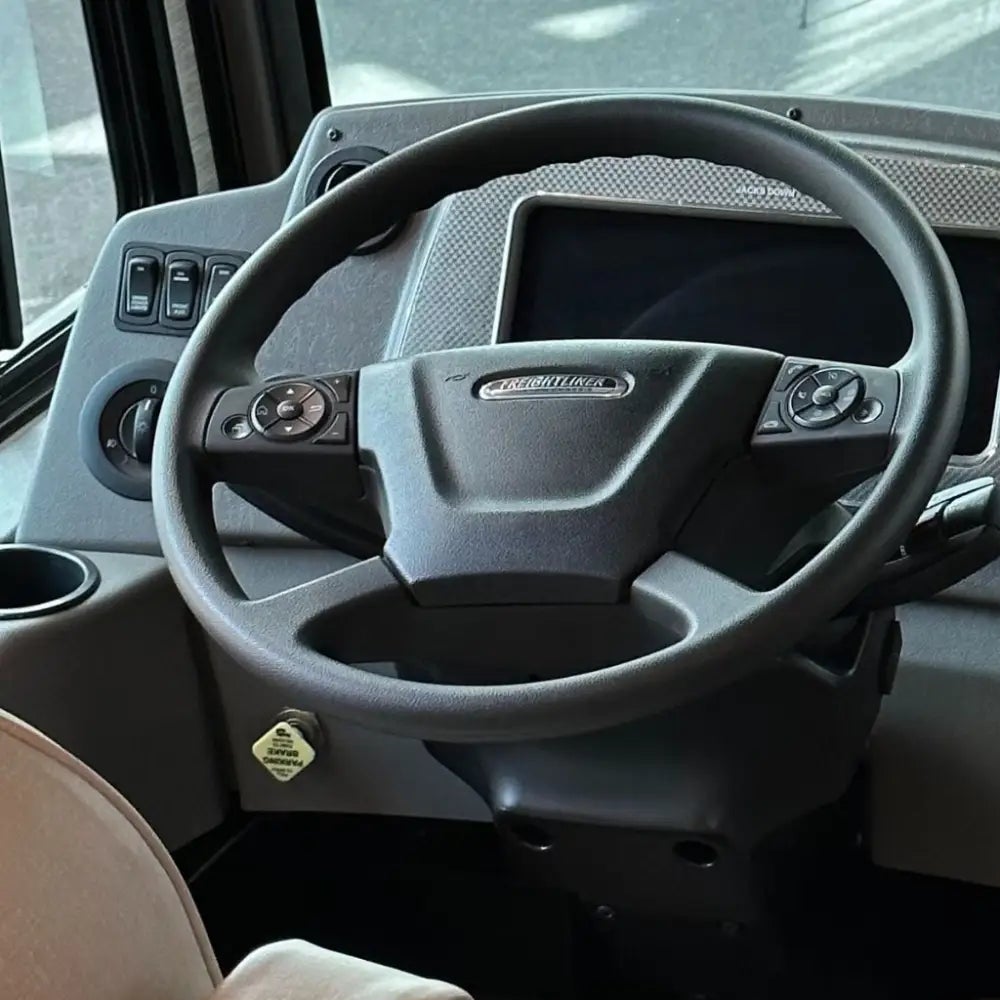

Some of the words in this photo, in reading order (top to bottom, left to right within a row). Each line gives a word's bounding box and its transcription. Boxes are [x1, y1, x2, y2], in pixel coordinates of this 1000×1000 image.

[735, 185, 766, 196] JACKS
[768, 187, 797, 198] DOWN
[500, 375, 604, 391] FREIGHTLINER
[267, 747, 300, 758] BRAKE
[262, 756, 304, 767] PARKING
